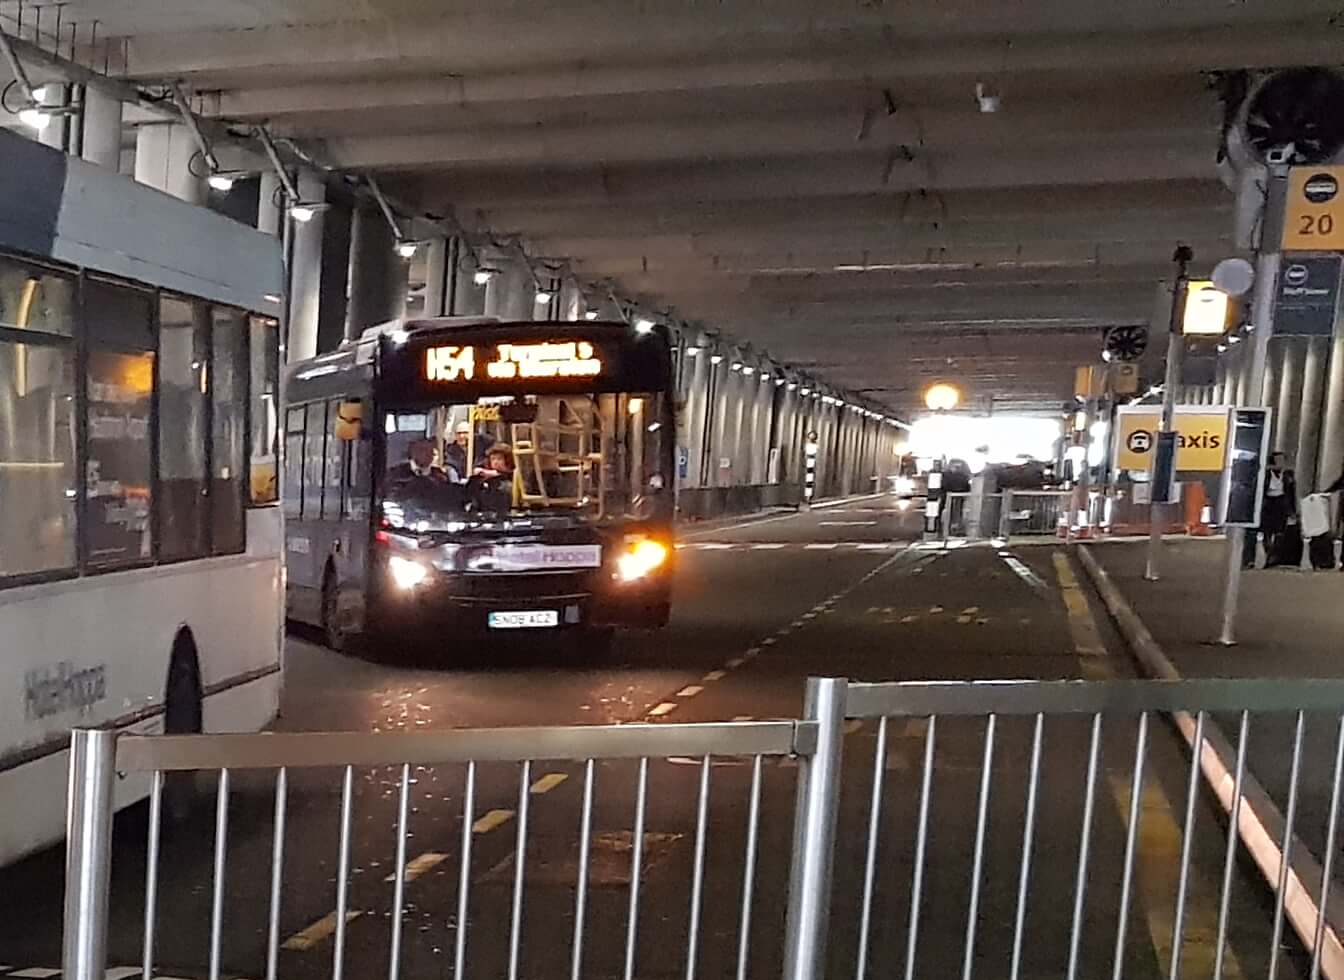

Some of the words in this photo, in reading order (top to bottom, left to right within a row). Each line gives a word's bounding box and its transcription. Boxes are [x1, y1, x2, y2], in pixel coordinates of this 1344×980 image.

[1298, 214, 1333, 236] 20
[426, 345, 475, 380] H54
[1176, 432, 1220, 450] axis
